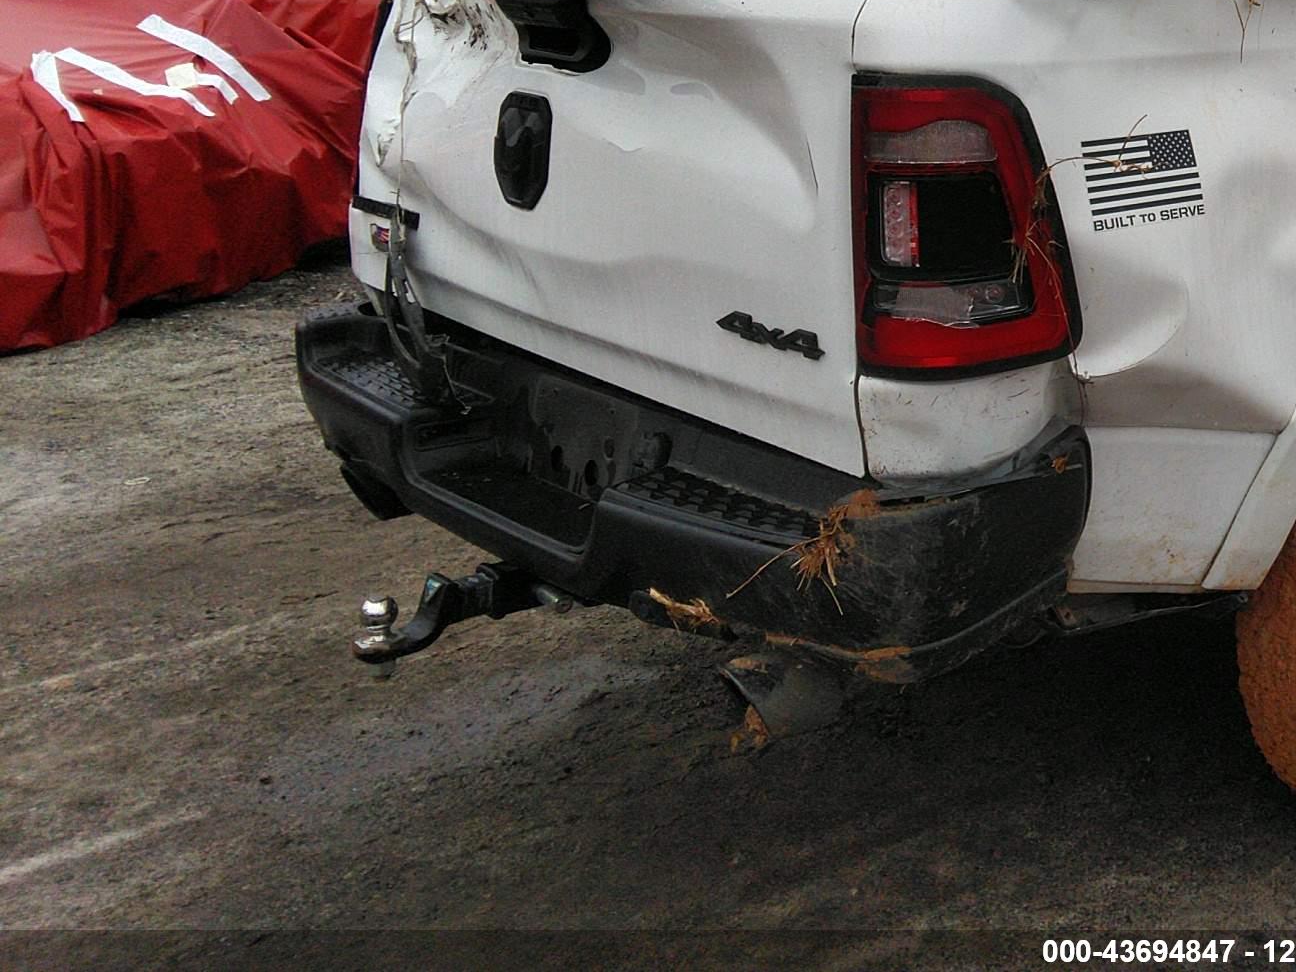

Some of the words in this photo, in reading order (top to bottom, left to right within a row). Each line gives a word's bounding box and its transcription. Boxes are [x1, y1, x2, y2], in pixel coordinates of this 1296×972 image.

[1093, 215, 1135, 232] BUILT
[1139, 212, 1156, 223] TO
[1160, 204, 1206, 221] SERVE
